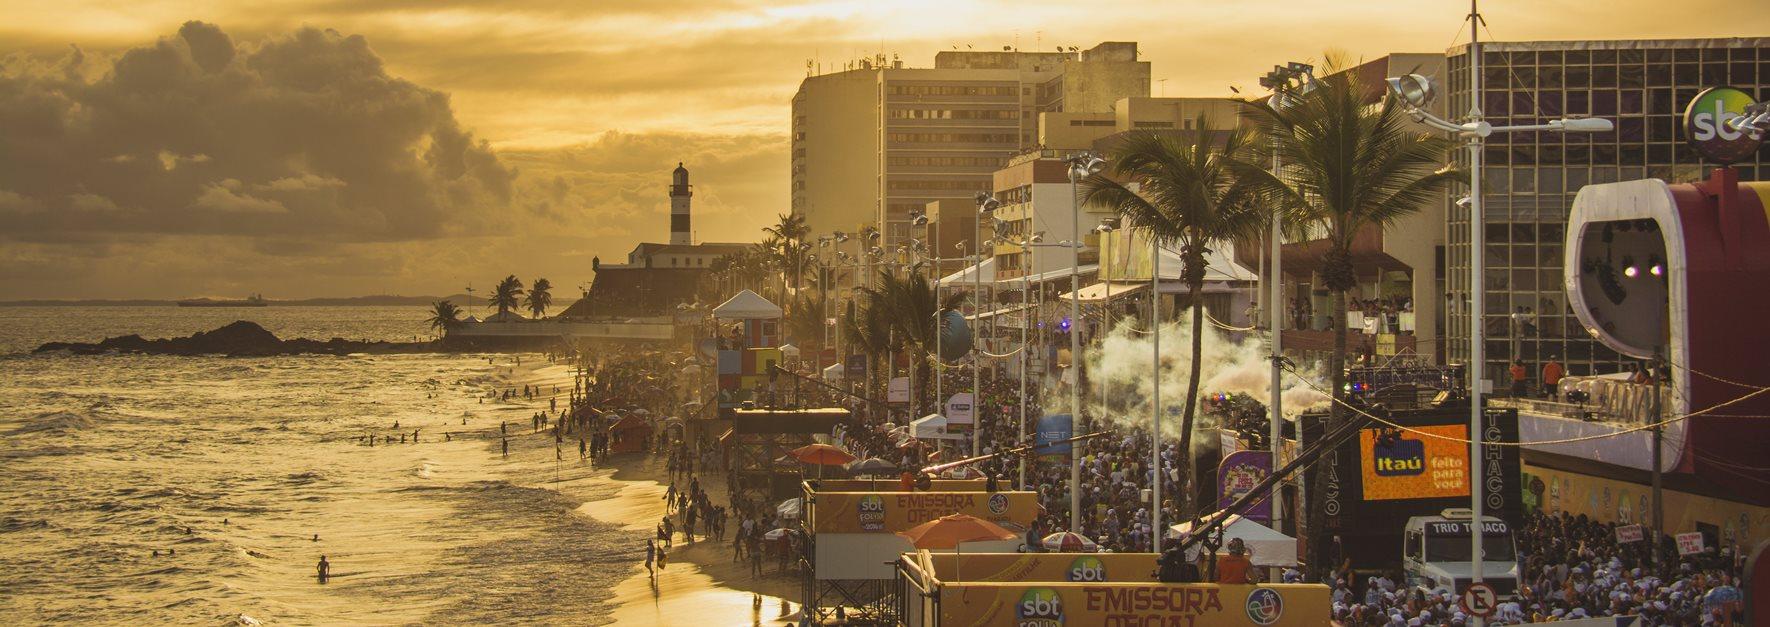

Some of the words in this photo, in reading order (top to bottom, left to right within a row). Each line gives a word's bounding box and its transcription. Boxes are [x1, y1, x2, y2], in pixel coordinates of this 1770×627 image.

[1040, 430, 1066, 440] NET
[1377, 456, 1422, 471] Itaú
[1431, 456, 1463, 468] feito
[1484, 410, 1504, 510] TCHACO
[1433, 469, 1464, 481] para
[861, 497, 883, 511] sbt
[896, 493, 976, 509] EMISSORA
[1433, 523, 1459, 533] TRIO
[1072, 563, 1103, 581] sbt
[1023, 592, 1060, 616] sbt
[1083, 587, 1223, 615] EMISSORA
[1473, 589, 1486, 609] E
